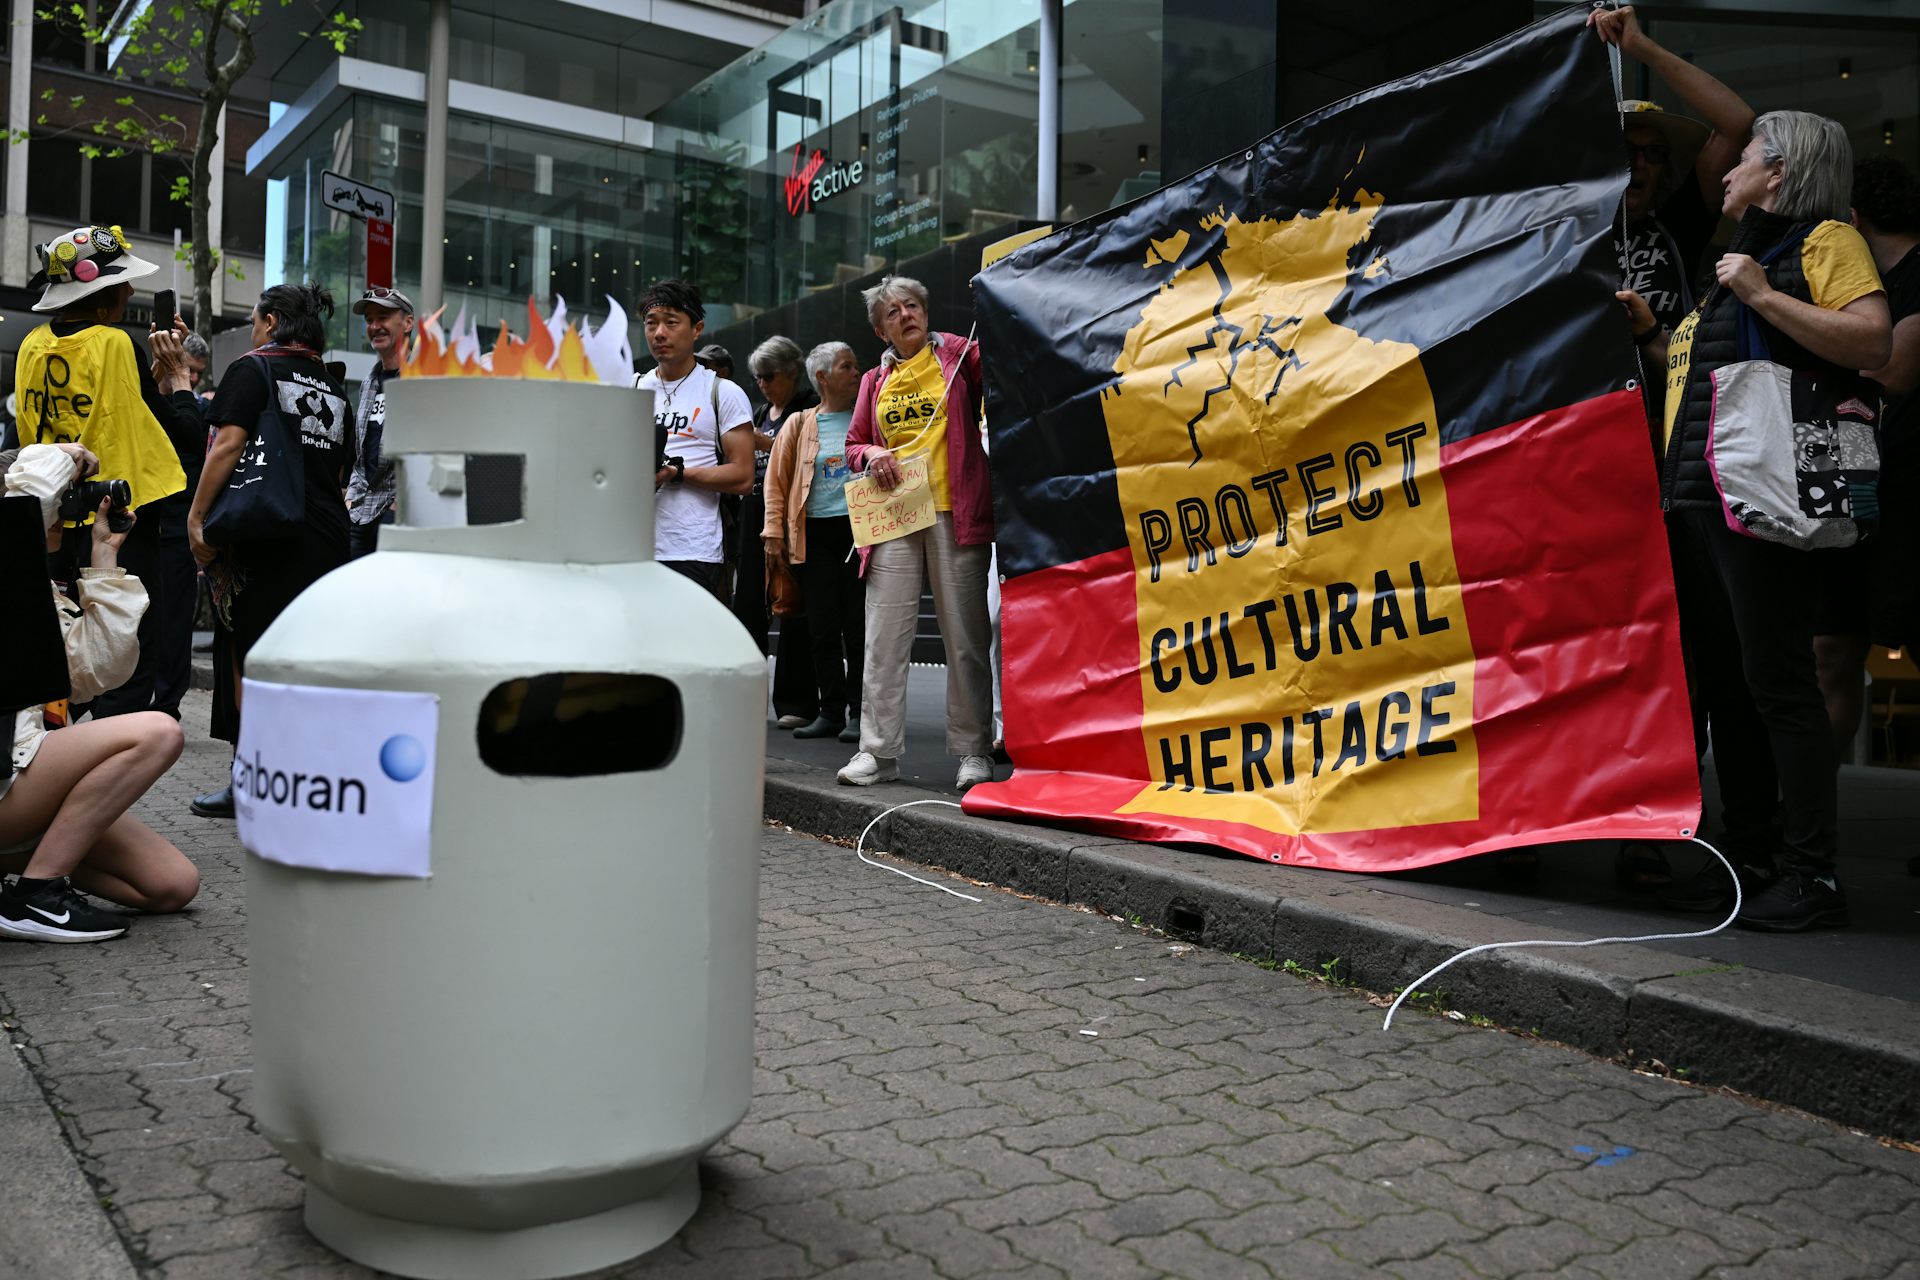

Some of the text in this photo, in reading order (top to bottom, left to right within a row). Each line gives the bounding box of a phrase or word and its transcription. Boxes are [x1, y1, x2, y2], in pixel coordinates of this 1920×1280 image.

[784, 143, 863, 217] Virgin active
[875, 192, 893, 207] Gym
[875, 197, 930, 227] Group Exercise
[874, 216, 938, 248] Personal Training
[24, 388, 93, 419] mre
[885, 402, 936, 425] GAS
[887, 397, 929, 411] COAL SEAM
[655, 407, 701, 435] Up!
[846, 468, 921, 503] TAMAN
[1138, 421, 1427, 584] PROTECT
[1149, 560, 1450, 694] CULTURAL
[1157, 681, 1457, 795] HERITAGE
